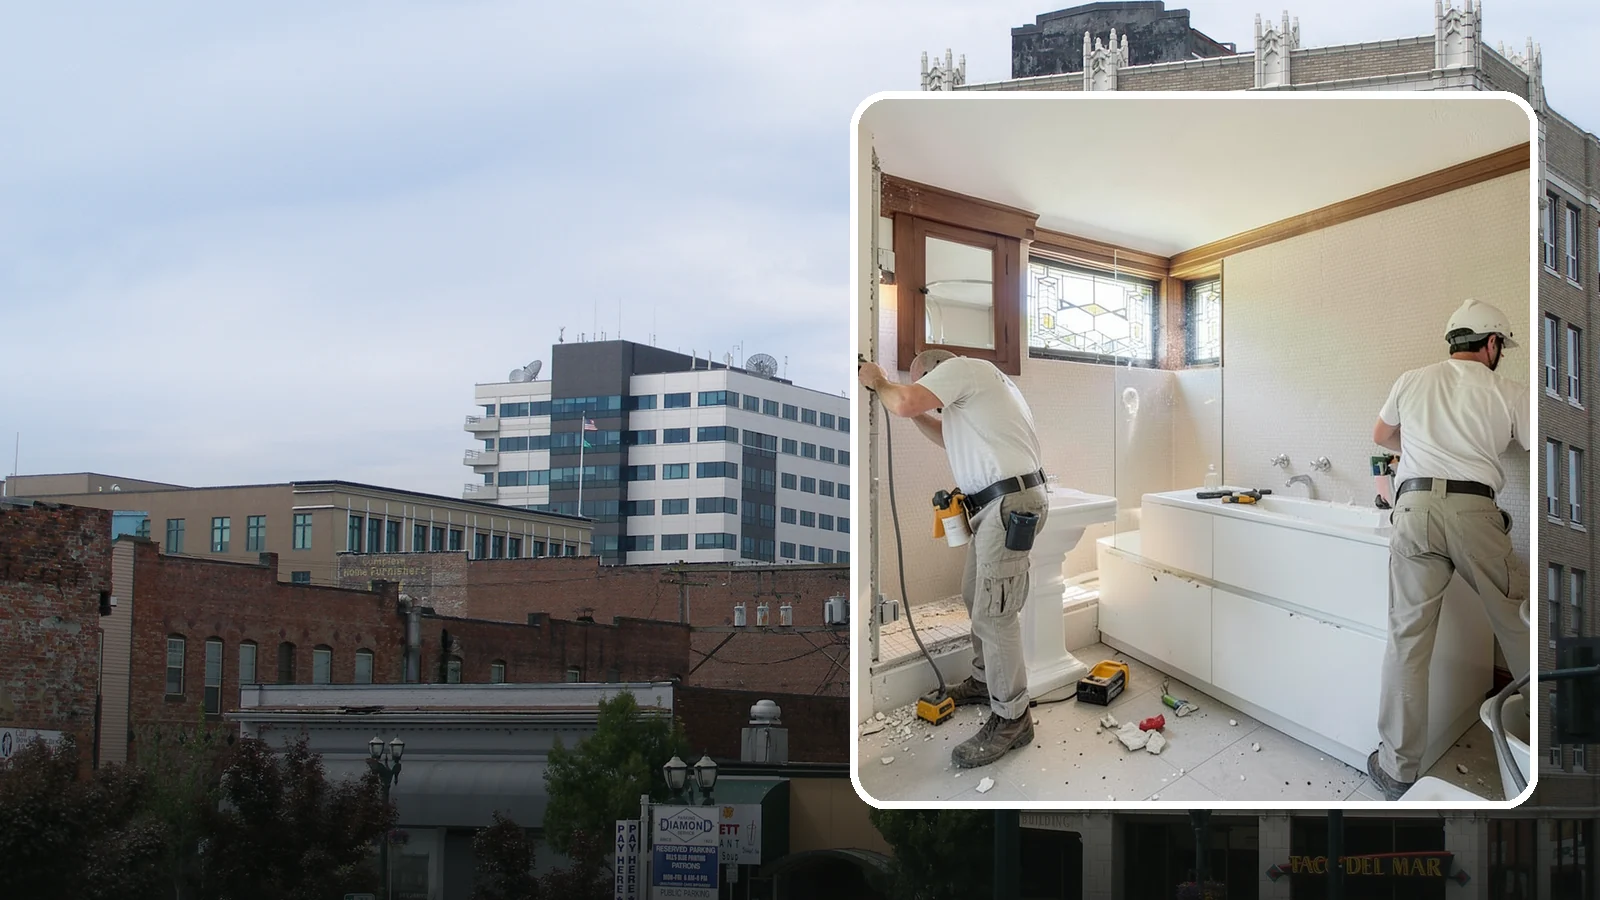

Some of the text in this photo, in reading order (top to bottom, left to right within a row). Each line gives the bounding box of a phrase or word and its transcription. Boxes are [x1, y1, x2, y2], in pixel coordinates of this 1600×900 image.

[370, 566, 428, 577] Furnishers
[660, 818, 713, 833] DIAMOND
[1021, 815, 1070, 828] BUILDING
[616, 825, 625, 894] PAY HERE
[627, 824, 637, 893] PAY HERE
[721, 851, 739, 863] Soup
[671, 862, 701, 870] PATRONS
[1346, 856, 1385, 875] DEL
[1392, 857, 1443, 876] MAR
[660, 888, 710, 898] PUBLIC PARKING
